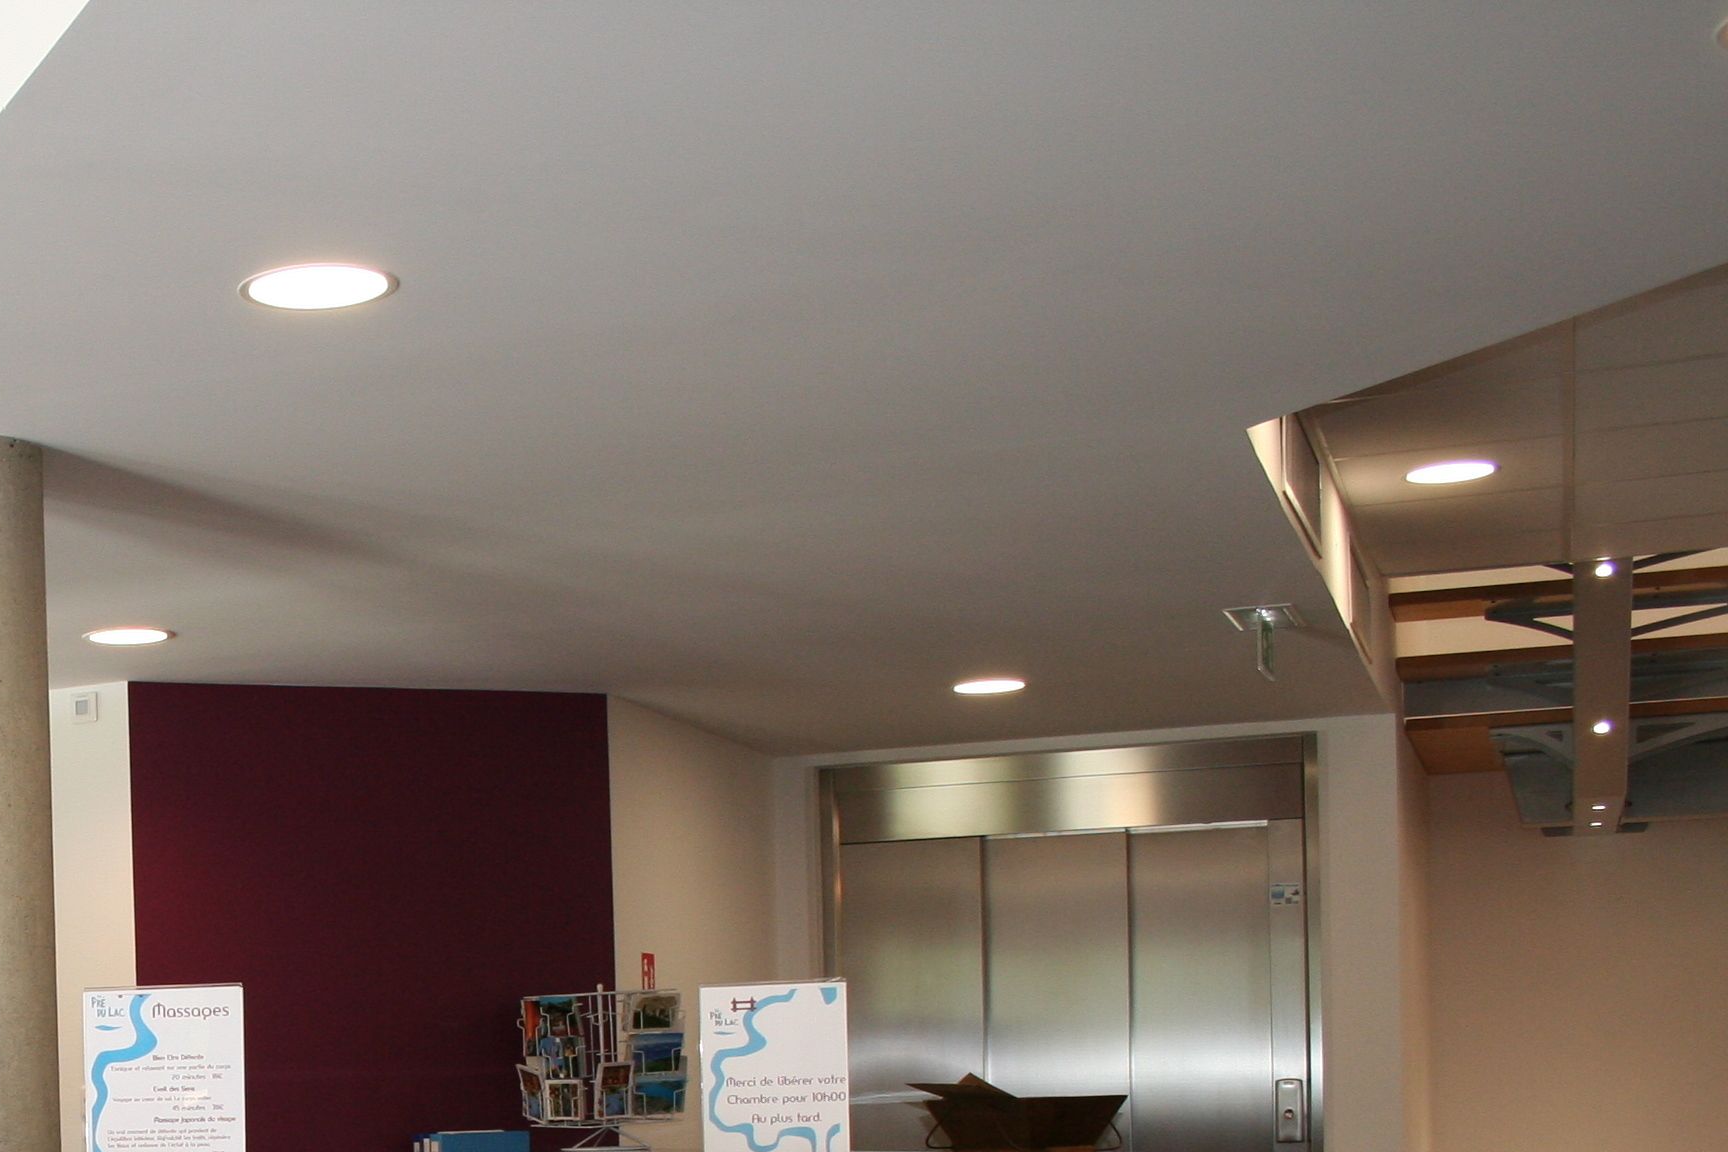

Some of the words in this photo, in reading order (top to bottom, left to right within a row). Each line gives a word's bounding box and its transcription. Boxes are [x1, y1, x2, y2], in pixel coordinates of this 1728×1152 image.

[152, 1002, 230, 1020] Massages
[726, 1077, 756, 1088] Merci
[760, 1077, 773, 1087] de
[777, 1076, 814, 1086] libérer
[818, 1075, 846, 1084] votre
[727, 1094, 778, 1105] Chambre
[782, 1095, 808, 1105] pour
[812, 1091, 846, 1102] 10h00
[751, 1113, 766, 1124] Au
[770, 1113, 793, 1125] plus
[797, 1112, 822, 1122] tard.
